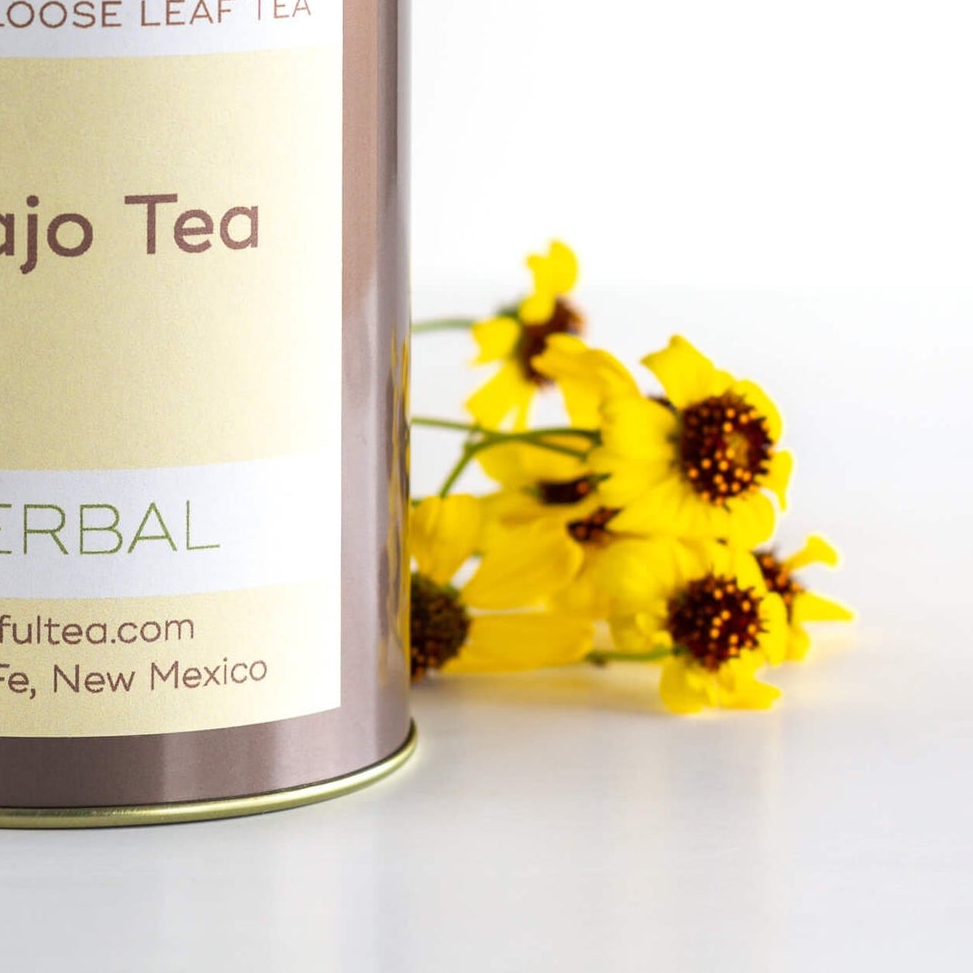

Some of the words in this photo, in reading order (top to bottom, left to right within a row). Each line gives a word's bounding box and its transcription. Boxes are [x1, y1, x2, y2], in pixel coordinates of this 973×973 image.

[123, 193, 261, 255] Tea
[53, 663, 136, 694] New
[150, 656, 268, 691] Mexico
